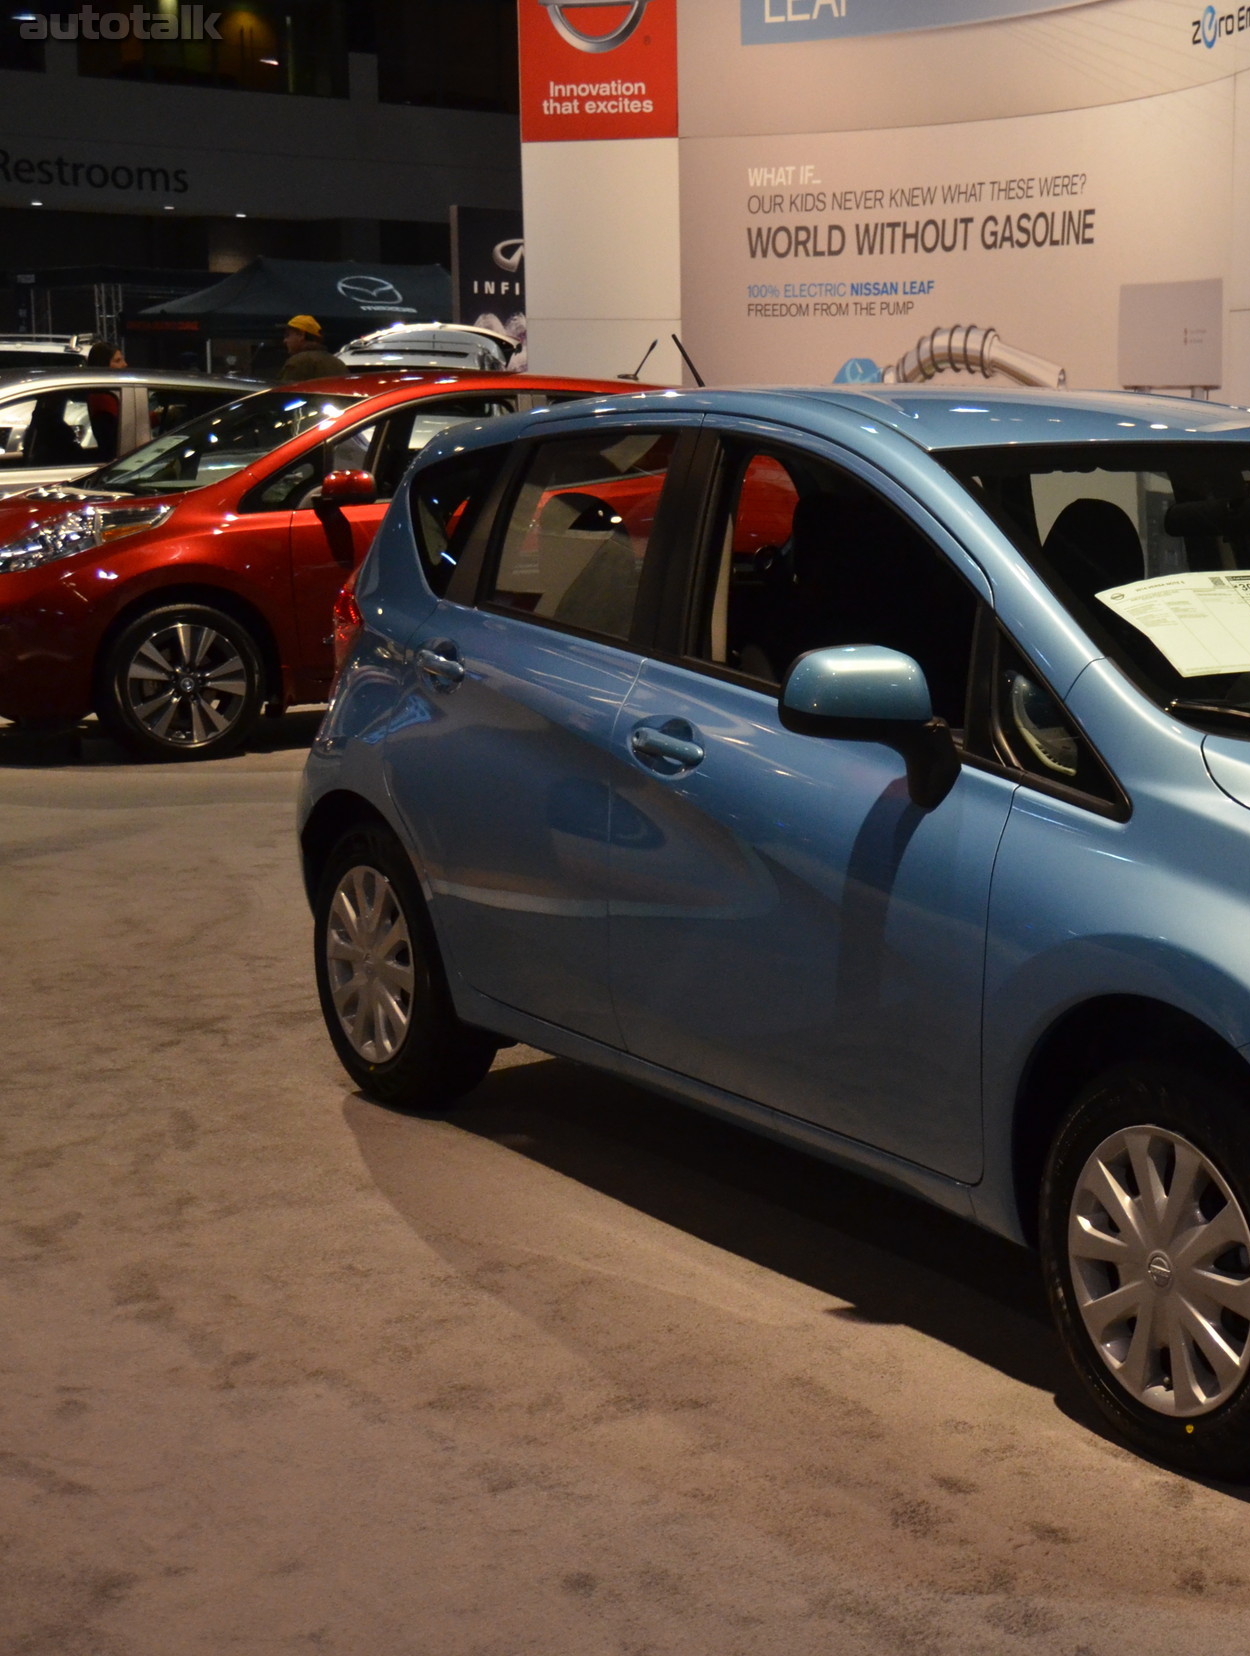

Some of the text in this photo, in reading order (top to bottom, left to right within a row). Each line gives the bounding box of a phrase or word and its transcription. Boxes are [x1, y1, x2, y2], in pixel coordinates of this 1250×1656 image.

[549, 80, 646, 97] Innovation
[542, 97, 654, 115] that excites
[0, 148, 189, 194] Restrooms
[747, 166, 796, 187] WHAT
[747, 173, 1087, 214] OUR KIDS NEVER KNEW WHAT THESE WERE?
[747, 208, 1096, 259] WORLD WITHOUT GASOLINE
[747, 280, 935, 298] 100% ELECTRIC NISSAN LEAF
[747, 301, 914, 317] FREEDOM FROM THE PUMP
